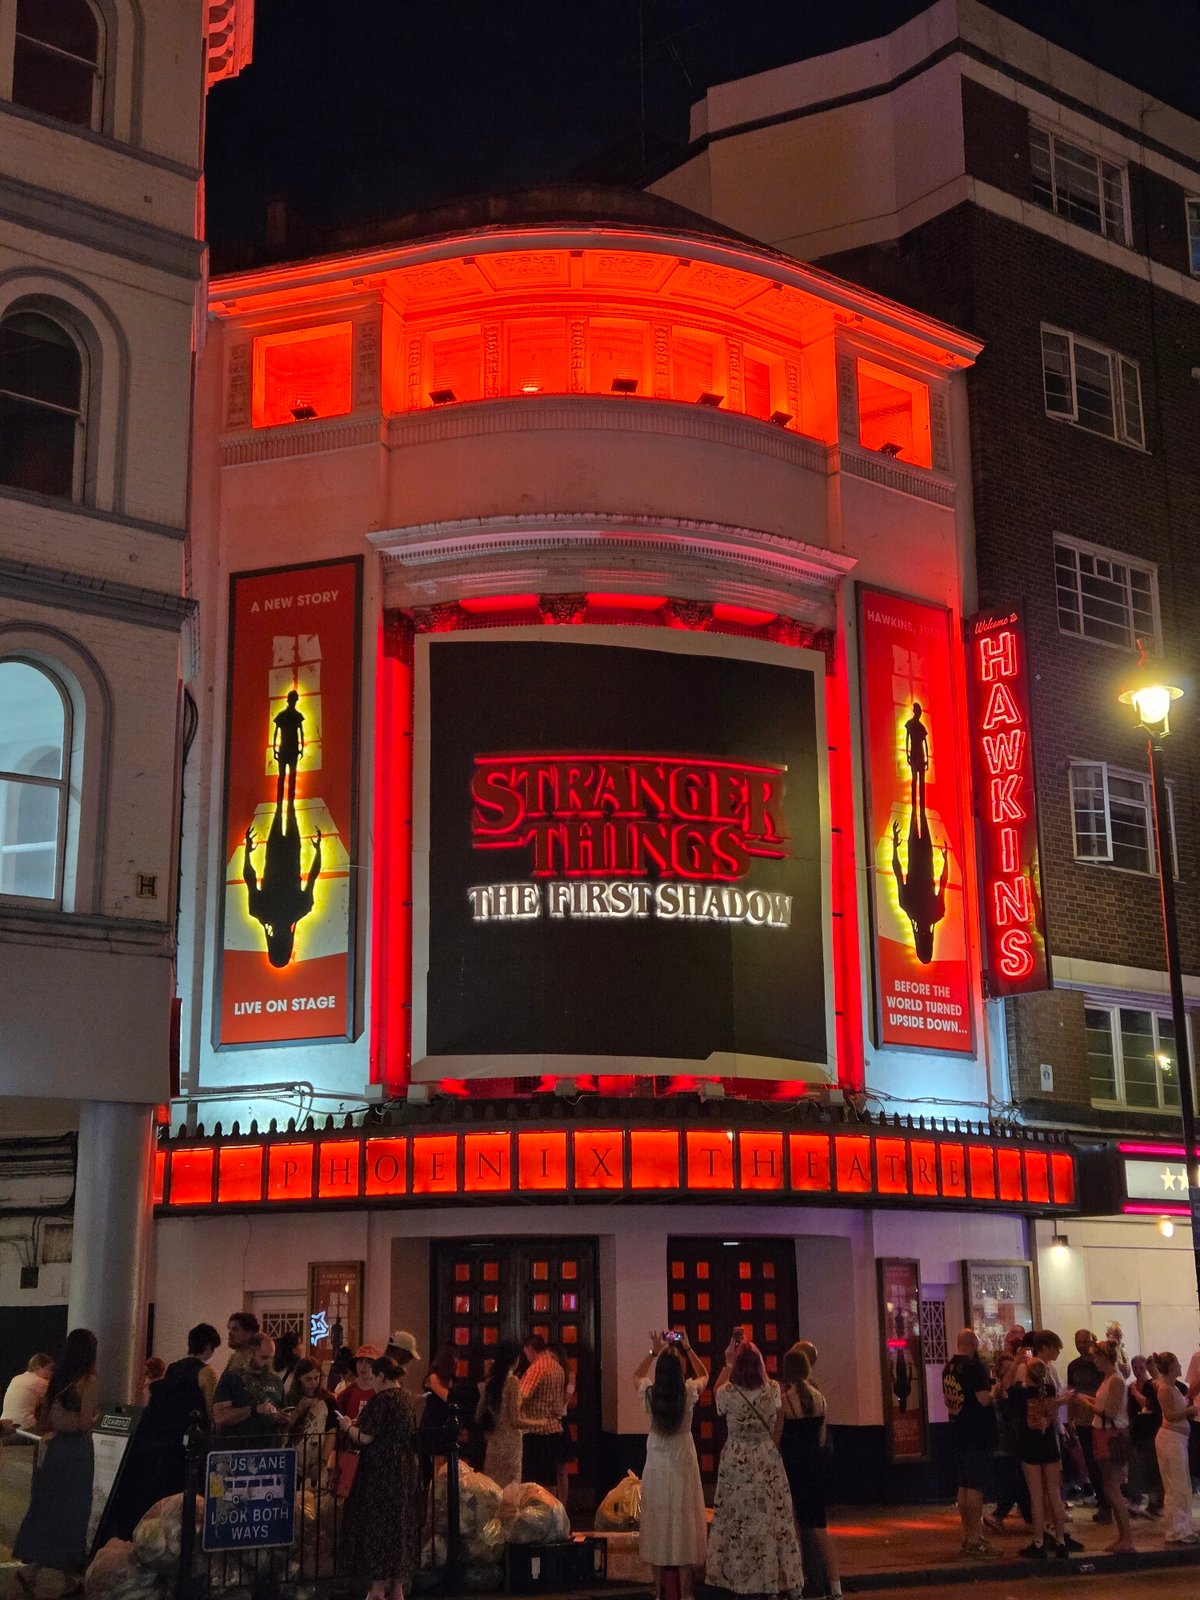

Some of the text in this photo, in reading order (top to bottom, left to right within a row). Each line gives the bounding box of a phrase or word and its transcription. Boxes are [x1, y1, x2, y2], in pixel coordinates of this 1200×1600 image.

[251, 590, 339, 613] A NEW STORY
[867, 609, 916, 635] HAWKINS,
[974, 612, 1019, 635] Welcome to
[471, 762, 788, 845] STRANGER
[979, 631, 1033, 977] HAWKINS
[523, 821, 751, 882] THINGS
[467, 881, 793, 927] THE FIRST SHADOW
[894, 980, 950, 998] BEFORE THE
[234, 996, 335, 1015] LIVE ON STAGE
[886, 996, 962, 1016] WORLD TURNED
[889, 1013, 967, 1033] UPSIDE DOWN...
[282, 1147, 962, 1188] PHOENIX THEATRE
[222, 1458, 247, 1472] US
[253, 1507, 289, 1522] BOTH
[232, 1525, 269, 1540] WAYS
